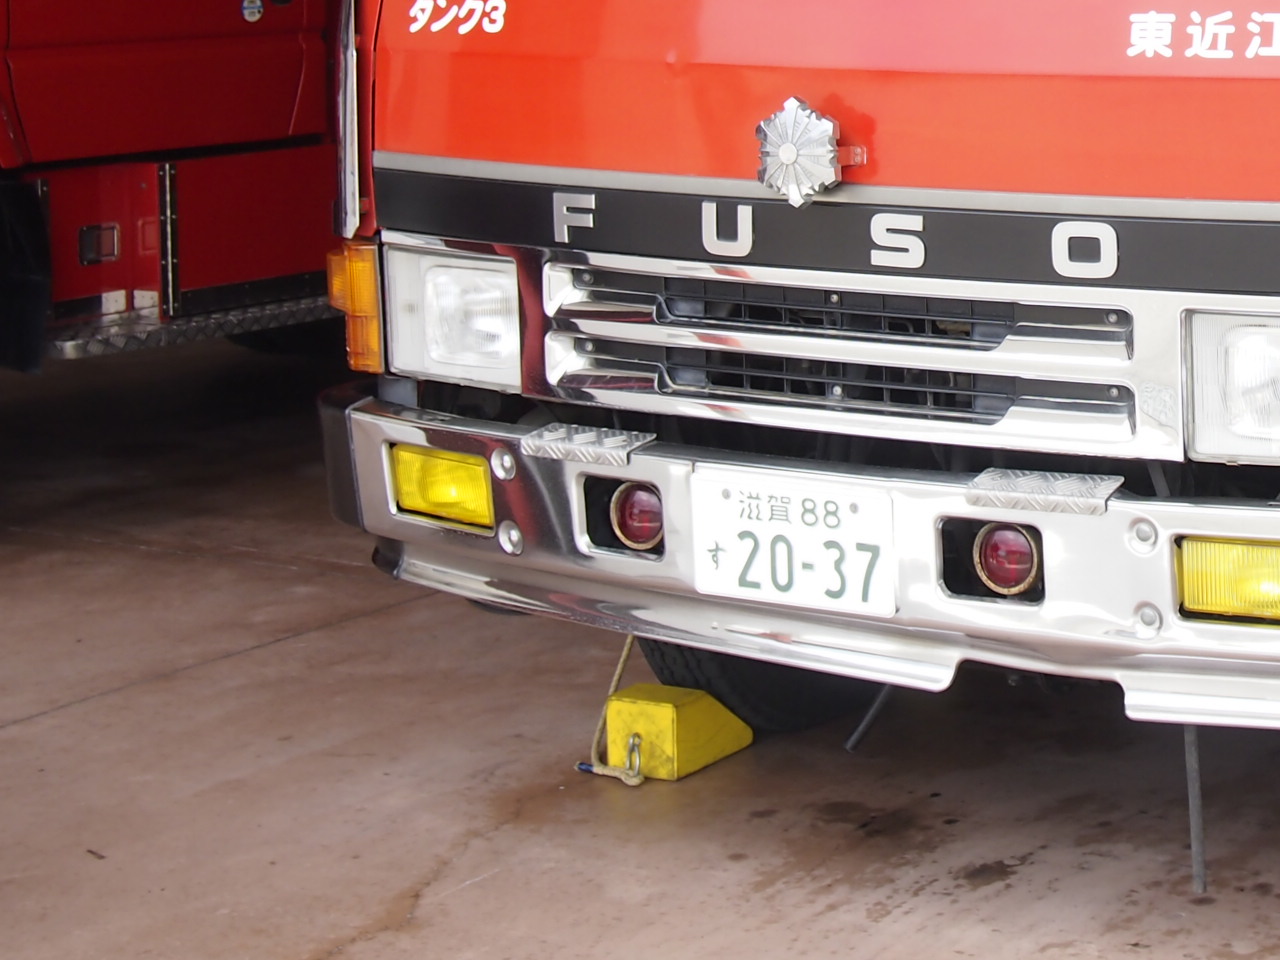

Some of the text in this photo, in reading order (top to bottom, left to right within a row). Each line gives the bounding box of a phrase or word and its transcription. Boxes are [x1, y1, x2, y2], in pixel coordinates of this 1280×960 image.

[552, 192, 1118, 279] FUSO
[739, 491, 841, 529] 滋賀 88
[737, 529, 881, 603] 20-37
